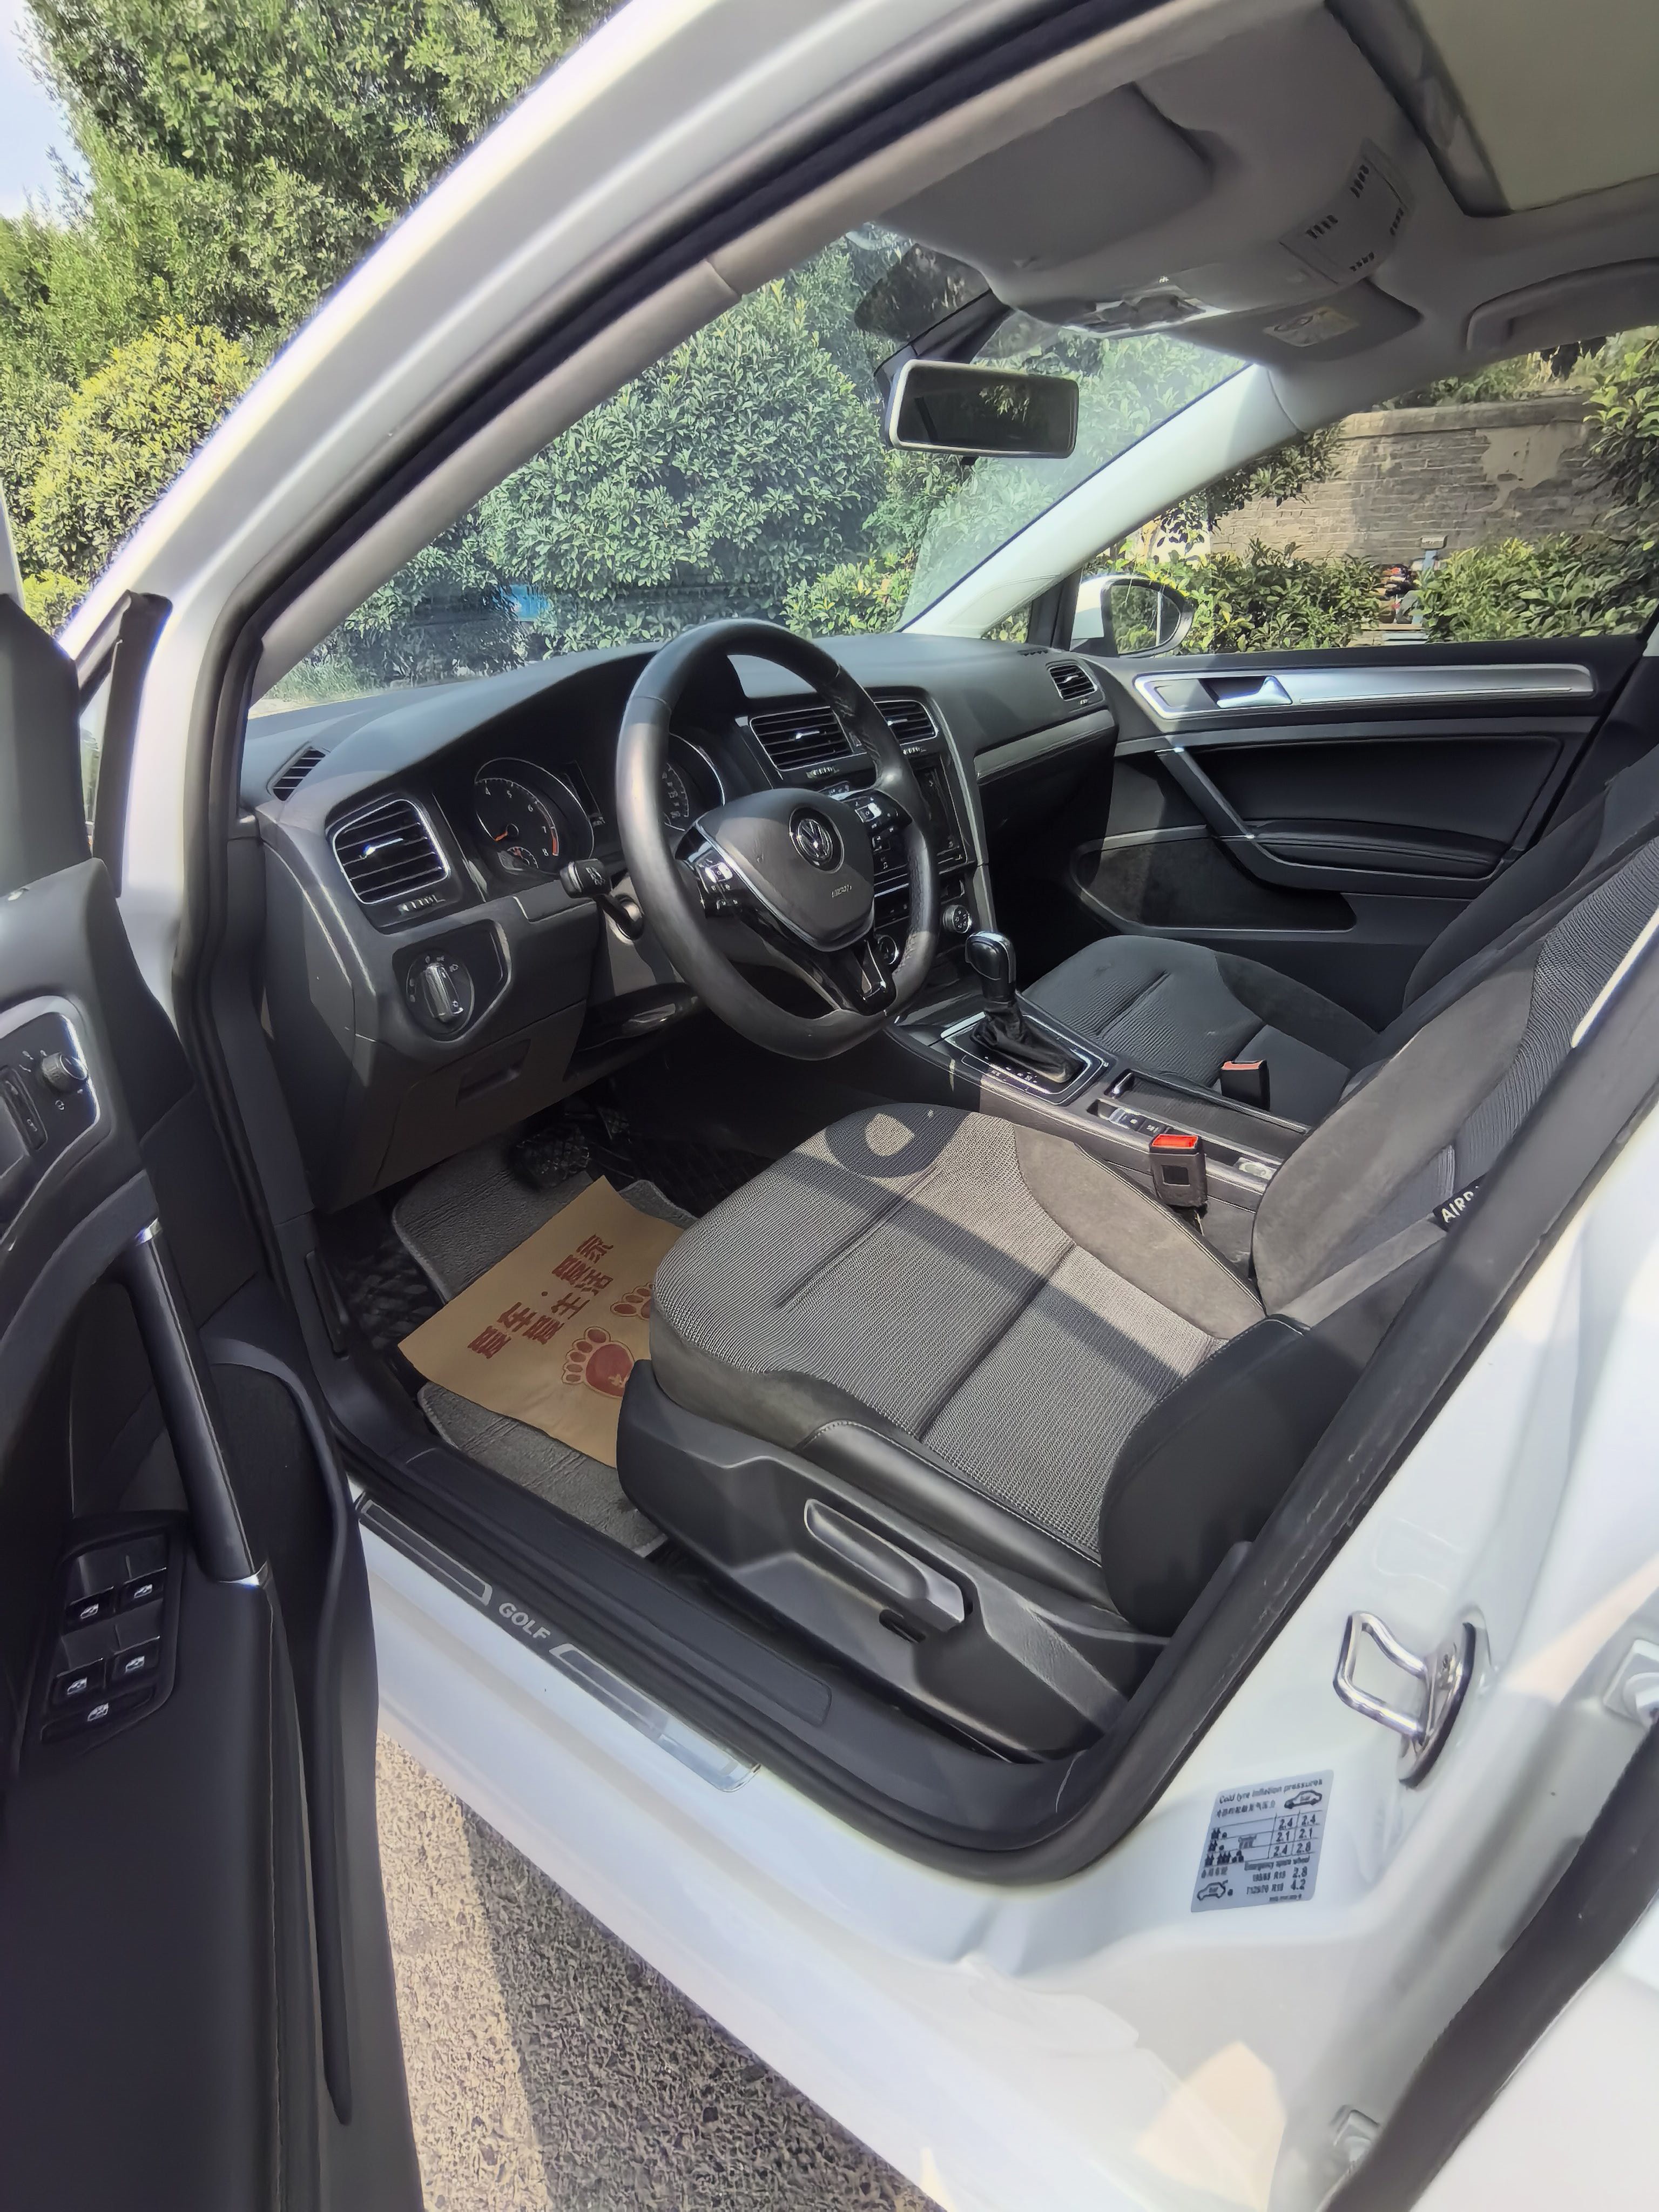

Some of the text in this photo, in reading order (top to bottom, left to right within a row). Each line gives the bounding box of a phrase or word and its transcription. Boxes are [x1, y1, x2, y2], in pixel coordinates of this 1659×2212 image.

[527, 804, 534, 812] 6
[542, 848, 549, 857] 8
[1441, 1185, 1479, 1223] AIR
[498, 1602, 551, 1638] GOLF
[1279, 1813, 1316, 1830] 2.4 2.4
[1276, 1827, 1313, 1842] 2.1 2.1
[1273, 1844, 1288, 1857] 2.4
[1292, 1866, 1307, 1878] 2.8
[1291, 1879, 1306, 1890] 4.2
